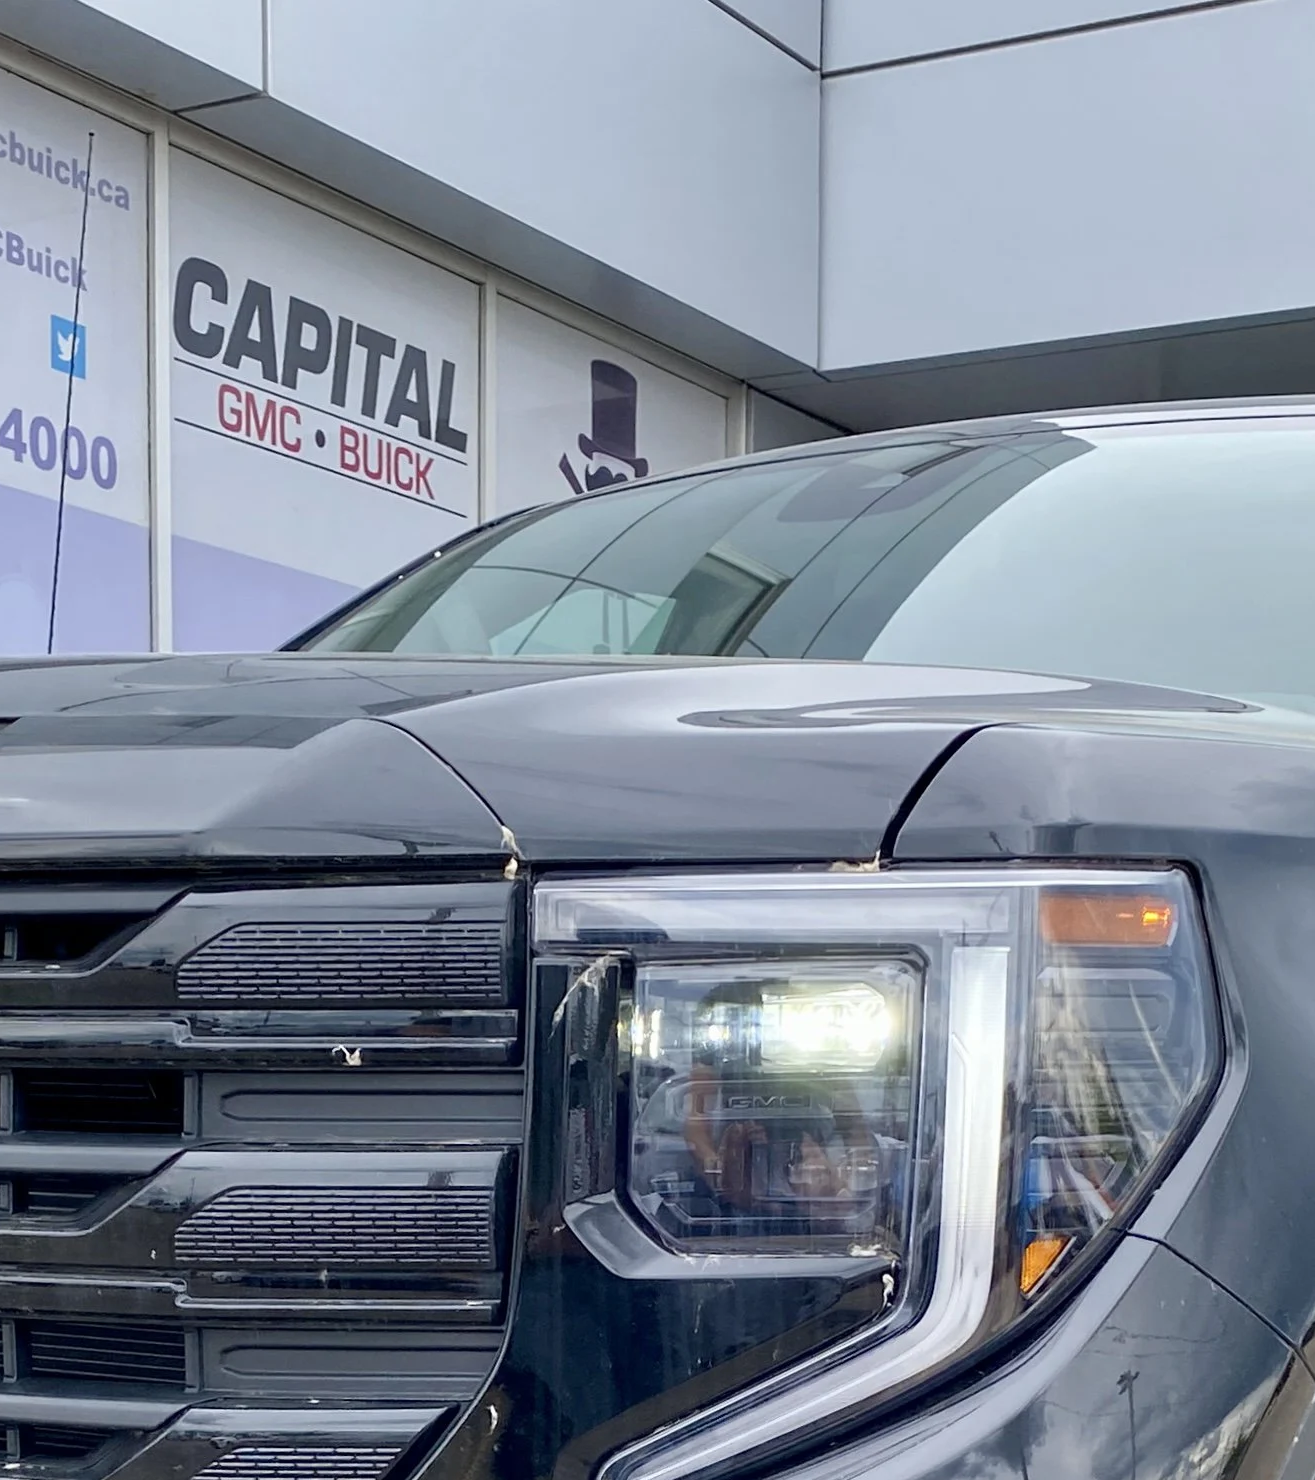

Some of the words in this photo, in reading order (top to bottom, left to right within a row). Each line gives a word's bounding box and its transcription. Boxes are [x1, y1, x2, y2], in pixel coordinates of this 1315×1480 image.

[173, 257, 468, 453] CAPITAL
[217, 384, 302, 453] GMC
[340, 425, 435, 500] BUICK
